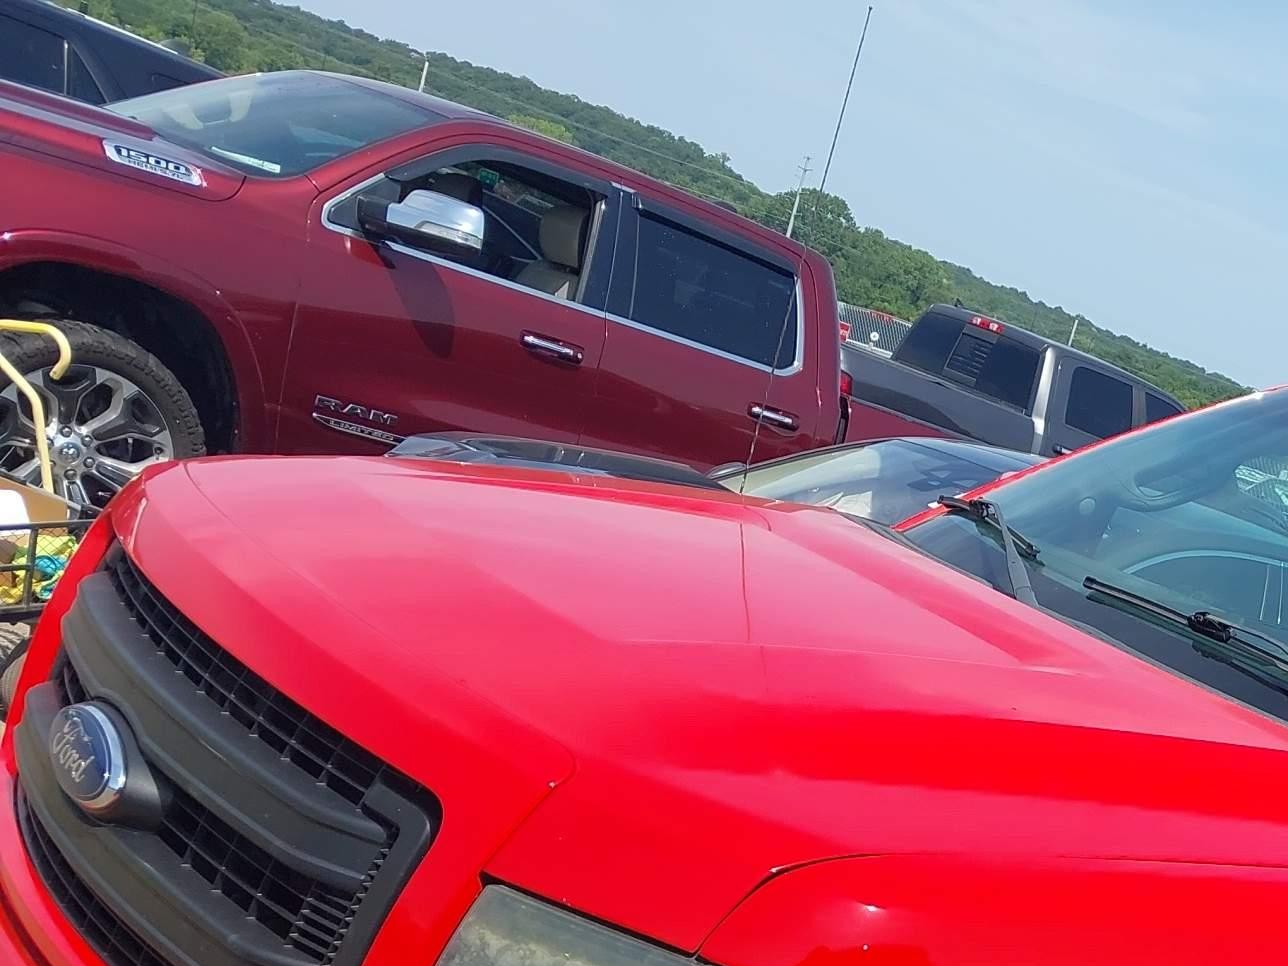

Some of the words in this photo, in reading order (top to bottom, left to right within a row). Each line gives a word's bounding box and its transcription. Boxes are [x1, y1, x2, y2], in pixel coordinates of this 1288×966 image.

[120, 146, 190, 175] 1500
[314, 394, 398, 425] RAM
[329, 419, 394, 441] LIMITED
[53, 717, 95, 783] Ford
